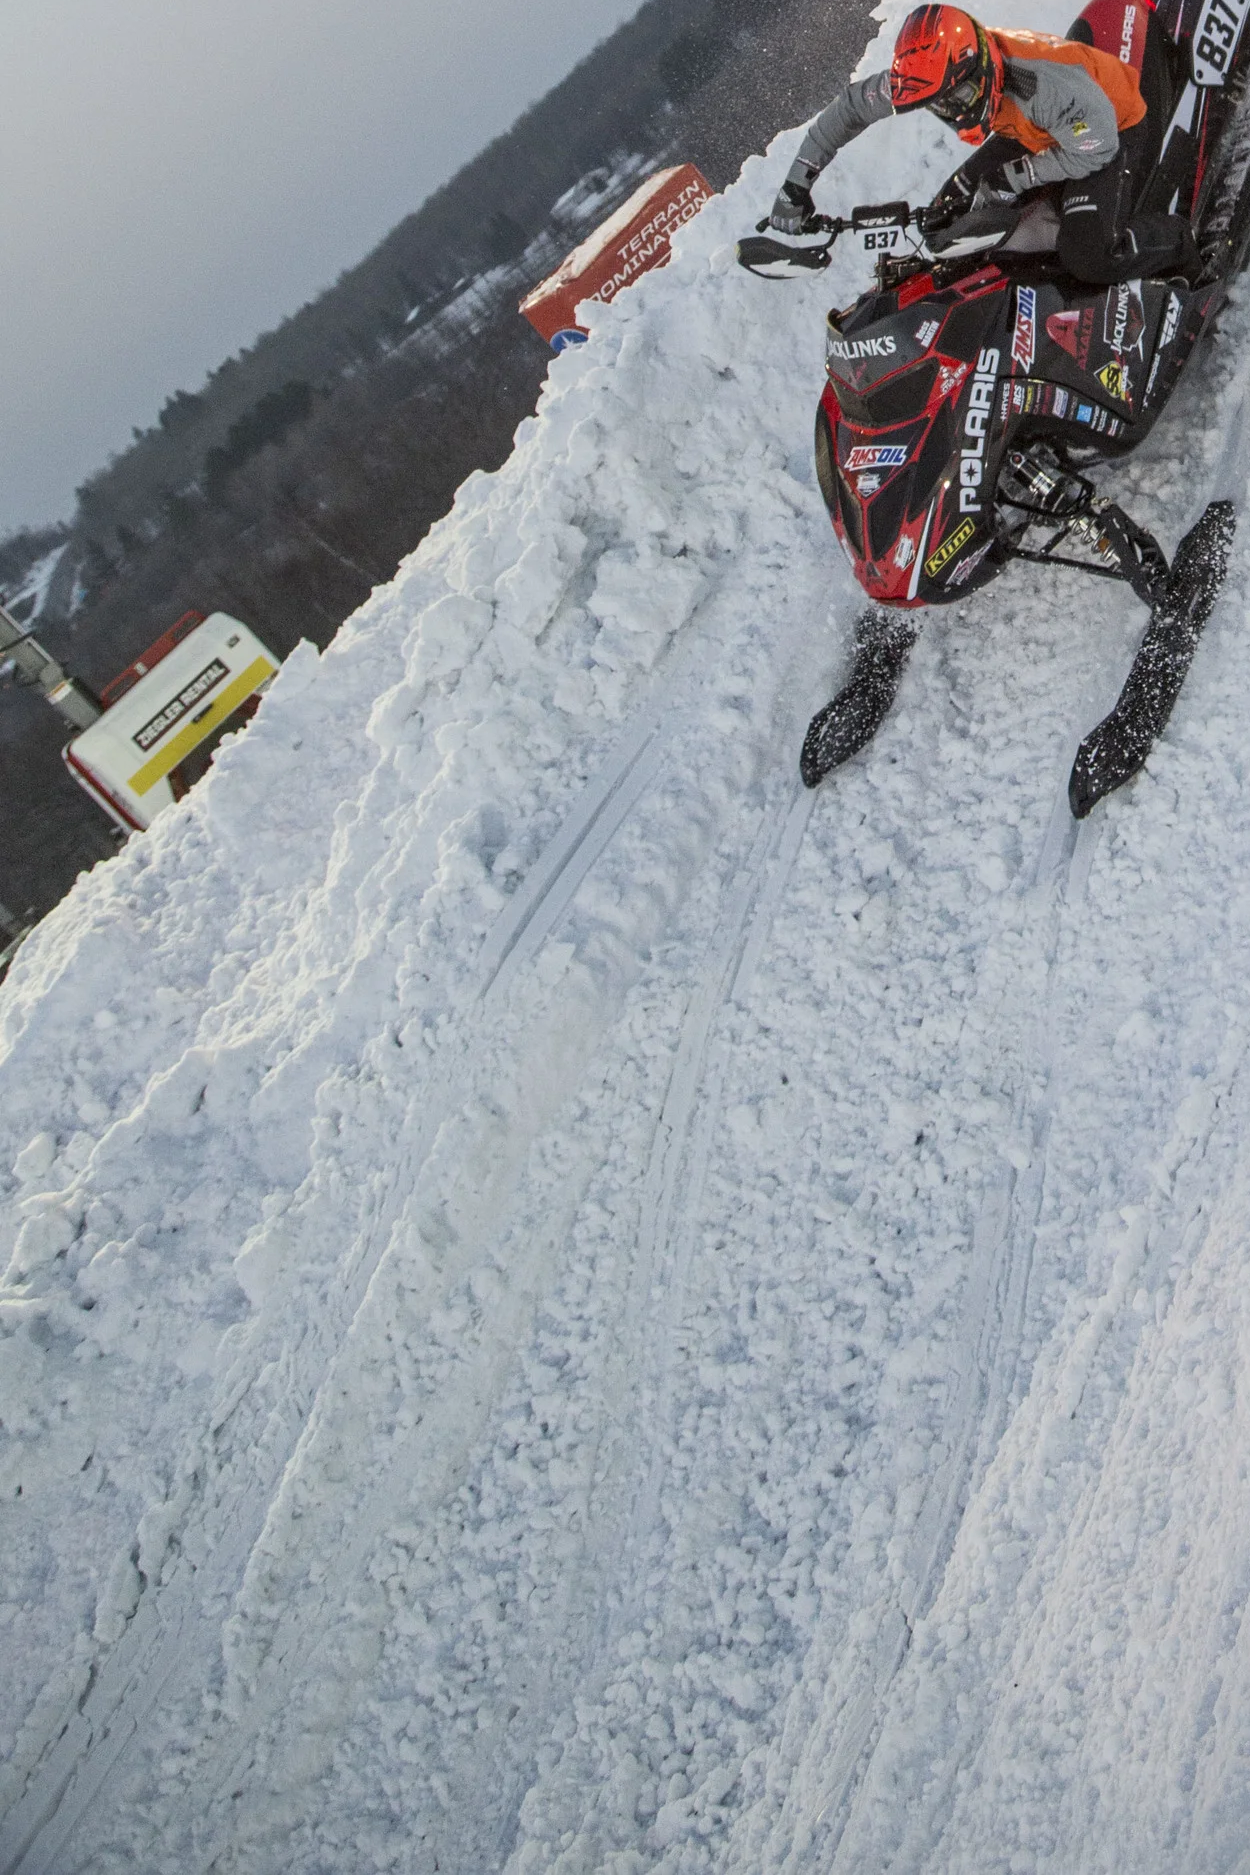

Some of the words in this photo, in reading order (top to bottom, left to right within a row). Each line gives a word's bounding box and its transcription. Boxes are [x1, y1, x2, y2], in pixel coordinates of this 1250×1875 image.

[1119, 4, 1136, 63] OLARIS
[589, 190, 709, 303] DOMINATION
[616, 179, 701, 261] TERRAIN
[864, 230, 899, 251] 837
[843, 335, 897, 360] LINK'S
[1013, 286, 1035, 370] AMSOIL
[1078, 307, 1095, 371] AXALTA
[1110, 320, 1127, 355] JACK
[1158, 291, 1180, 349] FLY
[848, 446, 906, 469] AMSOIL
[959, 347, 1000, 512] POLARIS
